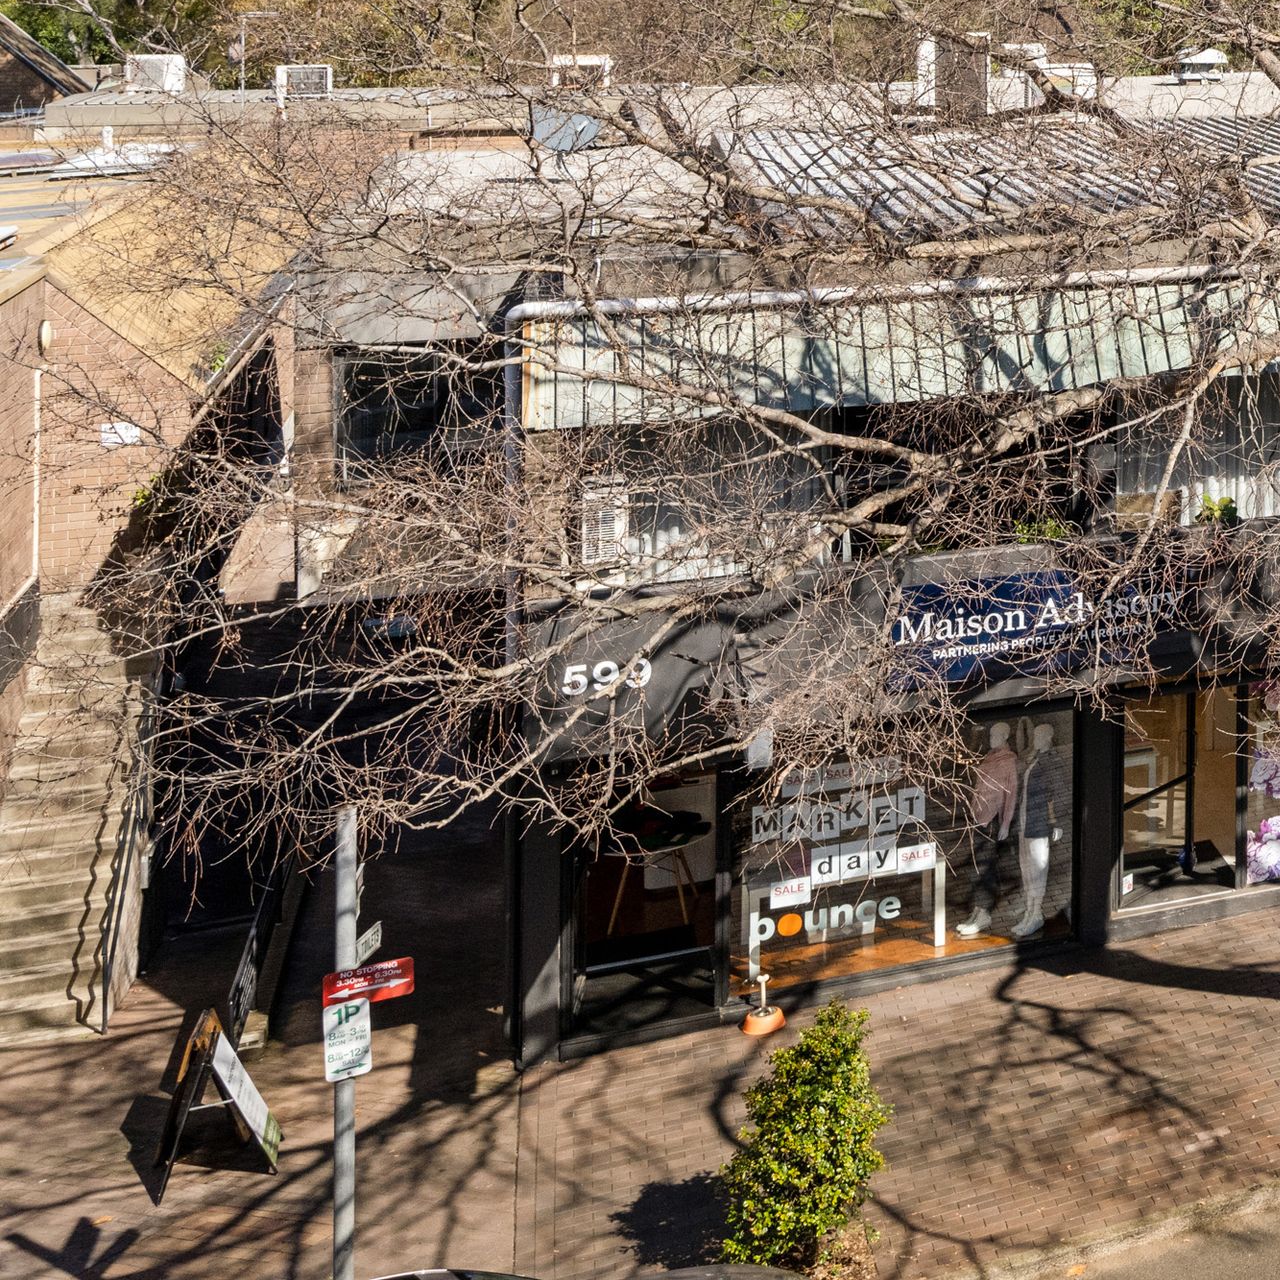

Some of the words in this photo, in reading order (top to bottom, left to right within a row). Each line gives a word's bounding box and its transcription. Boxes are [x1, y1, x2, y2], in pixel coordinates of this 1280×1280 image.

[895, 608, 1027, 646] Maison
[933, 640, 1009, 660] PARTNERING
[1011, 634, 1055, 650] PEOPLE
[562, 658, 652, 695] 599
[786, 771, 816, 786] SAE
[754, 795, 920, 835] MARKET
[817, 848, 889, 875] day
[901, 849, 930, 863] SALE
[774, 882, 805, 896] SALE
[749, 895, 902, 942] bounce
[336, 977, 364, 987] 3.30PM
[340, 970, 354, 979] NO
[356, 961, 398, 976] STOPPING
[332, 1004, 360, 1026] 1P
[328, 1039, 346, 1048] MON
